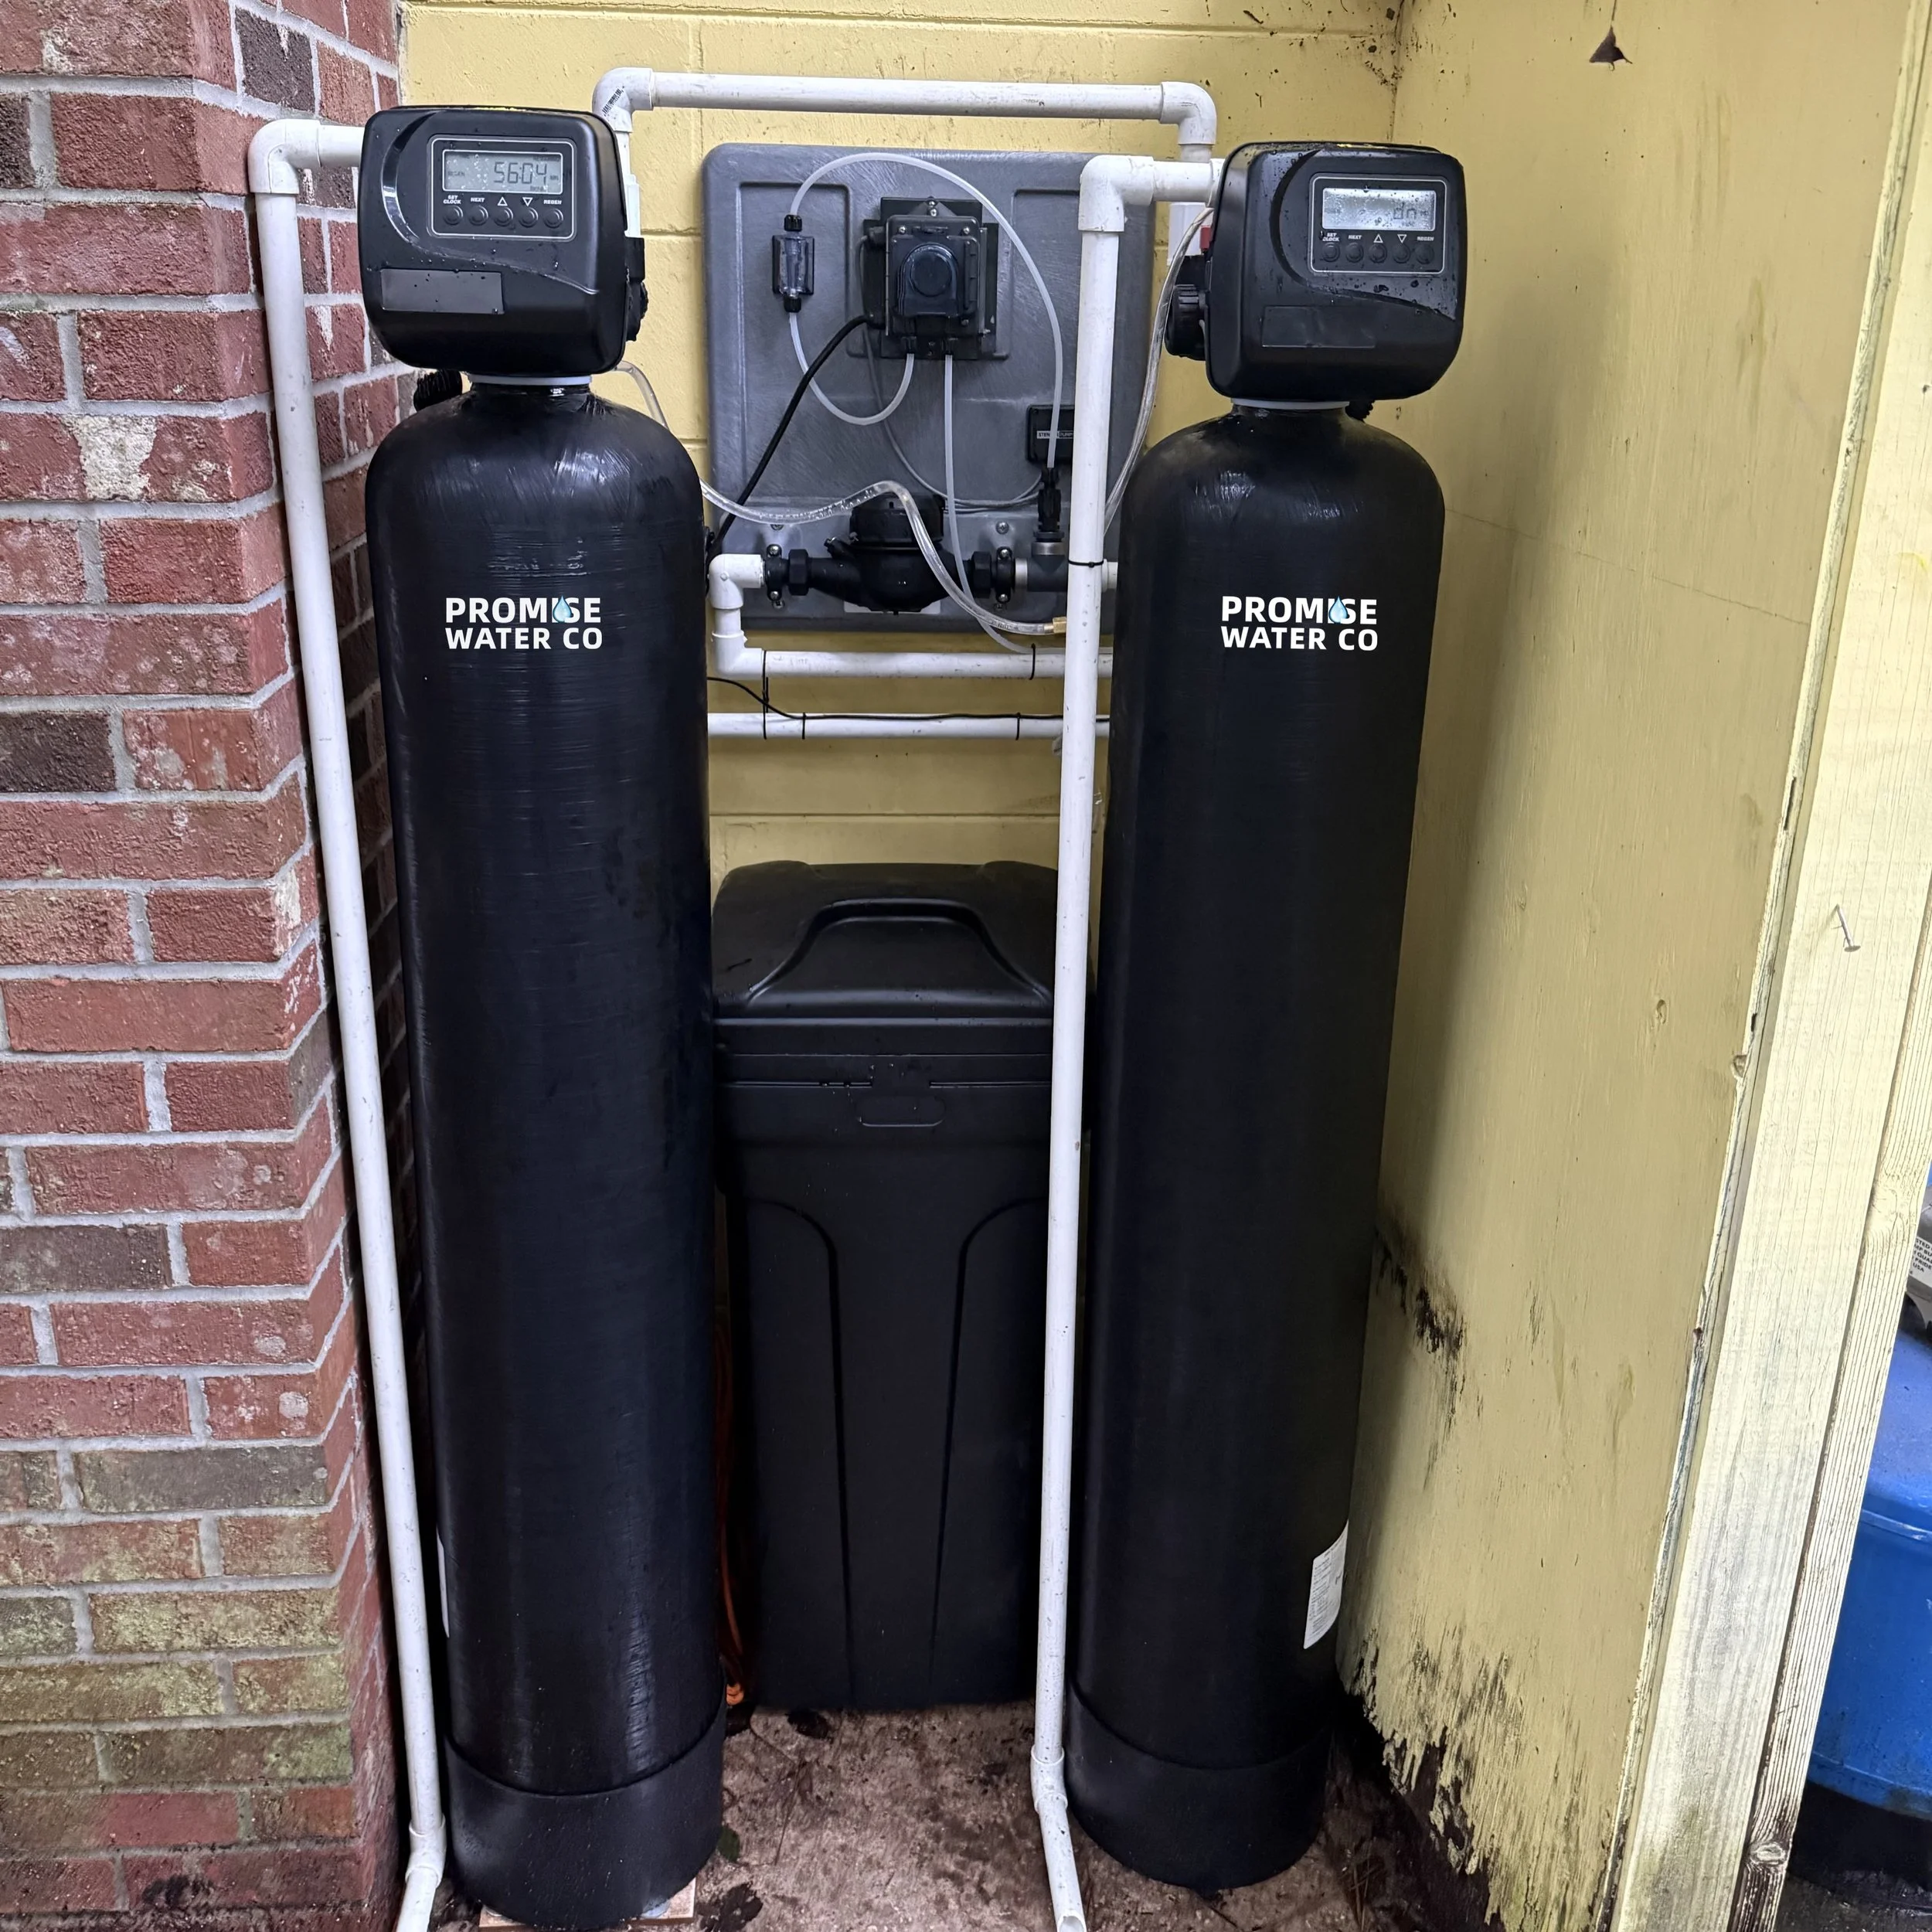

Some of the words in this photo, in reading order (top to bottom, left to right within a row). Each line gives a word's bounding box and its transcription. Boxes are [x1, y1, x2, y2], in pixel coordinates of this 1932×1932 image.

[445, 597, 601, 624] PROMISE
[1221, 595, 1377, 624] PROMISE
[445, 628, 552, 649] WATER
[563, 627, 603, 650] CO
[1220, 626, 1327, 650] WATER
[1338, 628, 1378, 651] CO
[1913, 1262, 1924, 1272] USA
